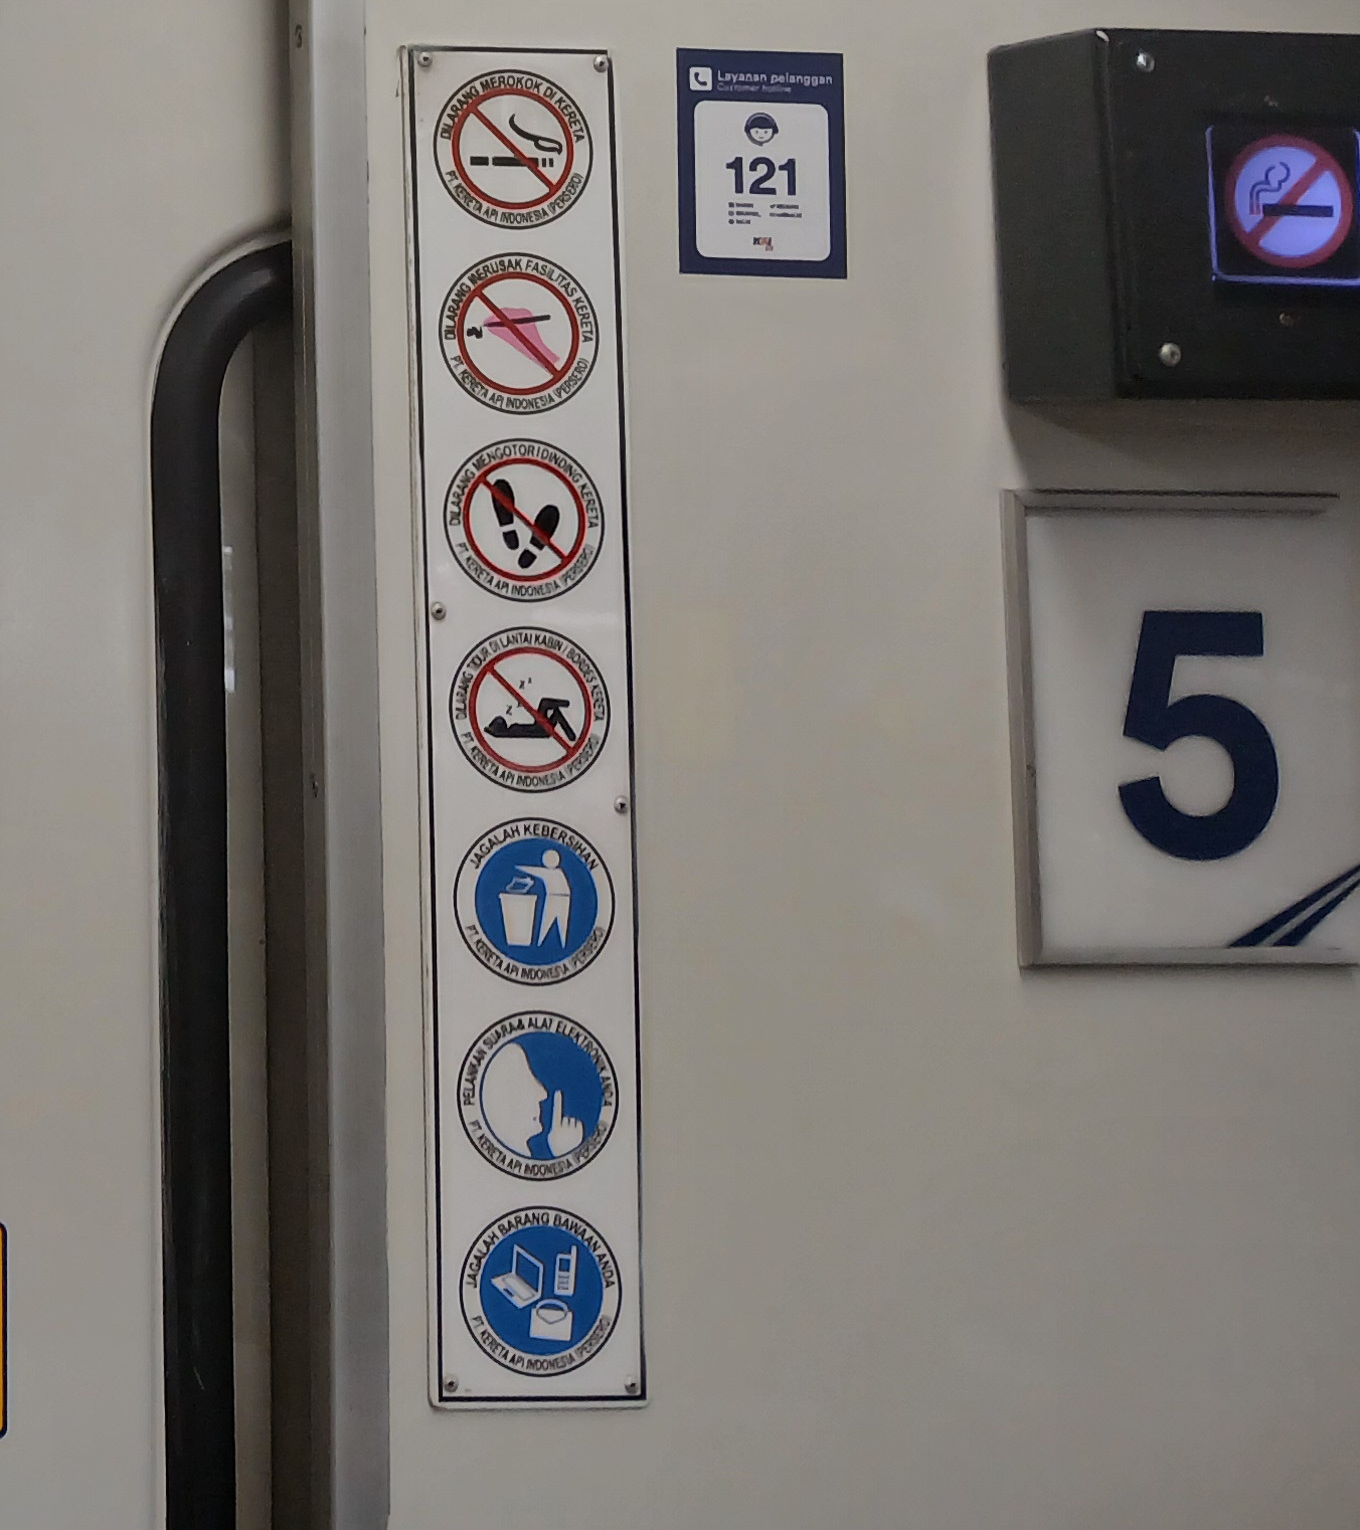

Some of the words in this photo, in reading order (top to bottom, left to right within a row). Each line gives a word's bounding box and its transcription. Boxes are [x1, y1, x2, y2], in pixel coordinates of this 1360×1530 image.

[440, 84, 480, 140] DILARANG
[480, 75, 543, 93] MEROKOK
[543, 86, 557, 101] DI
[554, 98, 585, 143] KERETA
[717, 70, 767, 83] Layanan
[770, 73, 832, 86] pelanggan
[453, 180, 482, 212] KERETA
[483, 205, 499, 220] API
[500, 209, 549, 224] INDONESIA
[726, 156, 796, 196] 121
[444, 283, 472, 340] DILARANG
[468, 258, 523, 286] MERUSAK
[525, 259, 577, 297] FASILITAS
[573, 297, 593, 343] KERETA
[458, 369, 487, 398] KERETA
[489, 393, 504, 409] API
[506, 395, 555, 409] INDONESIA
[449, 469, 475, 526] DILARANG
[540, 445, 582, 483] DINDING
[579, 482, 598, 529] KERETA
[456, 671, 474, 720] DILARANG
[501, 633, 533, 648] LANTAI
[534, 634, 564, 650] KABIN
[1118, 611, 1279, 860] 5
[469, 825, 521, 869] JAGALAH
[523, 823, 599, 870] KEBERSIHAN
[482, 1021, 519, 1050] SUARA
[528, 1017, 554, 1032] ALAT
[556, 1020, 609, 1073] ELEKTRONIK
[465, 1232, 500, 1289] JAGALAH
[497, 1212, 550, 1236] BARANG
[553, 1214, 601, 1253] BAWAAN
[597, 1253, 616, 1289] ANDA
